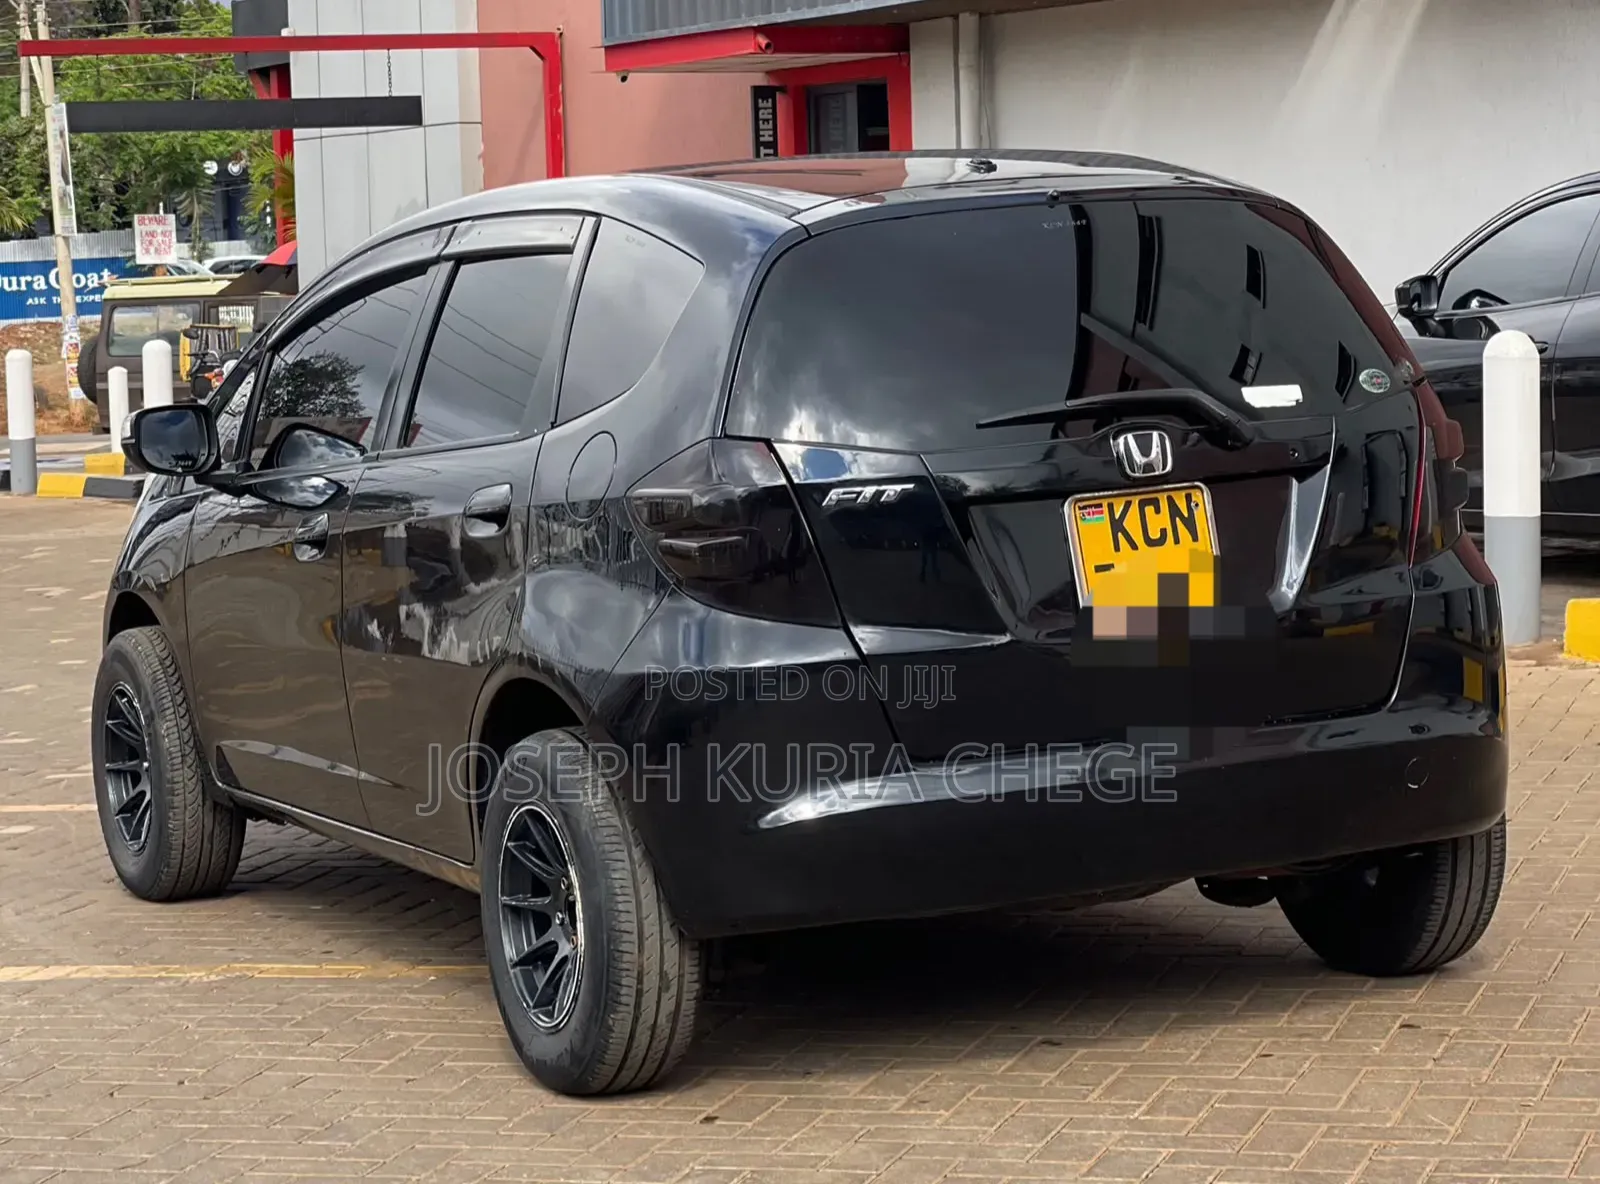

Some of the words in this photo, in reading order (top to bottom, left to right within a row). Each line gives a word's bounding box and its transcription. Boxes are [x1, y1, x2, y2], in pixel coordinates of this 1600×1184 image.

[758, 98, 774, 142] HERE
[137, 215, 169, 226] BEWARE
[140, 229, 158, 239] LAND
[0, 268, 111, 292] uraCoat
[26, 296, 47, 305] ASK
[75, 294, 104, 303] EXPE
[822, 483, 915, 506] FIT
[1106, 492, 1199, 553] KCN
